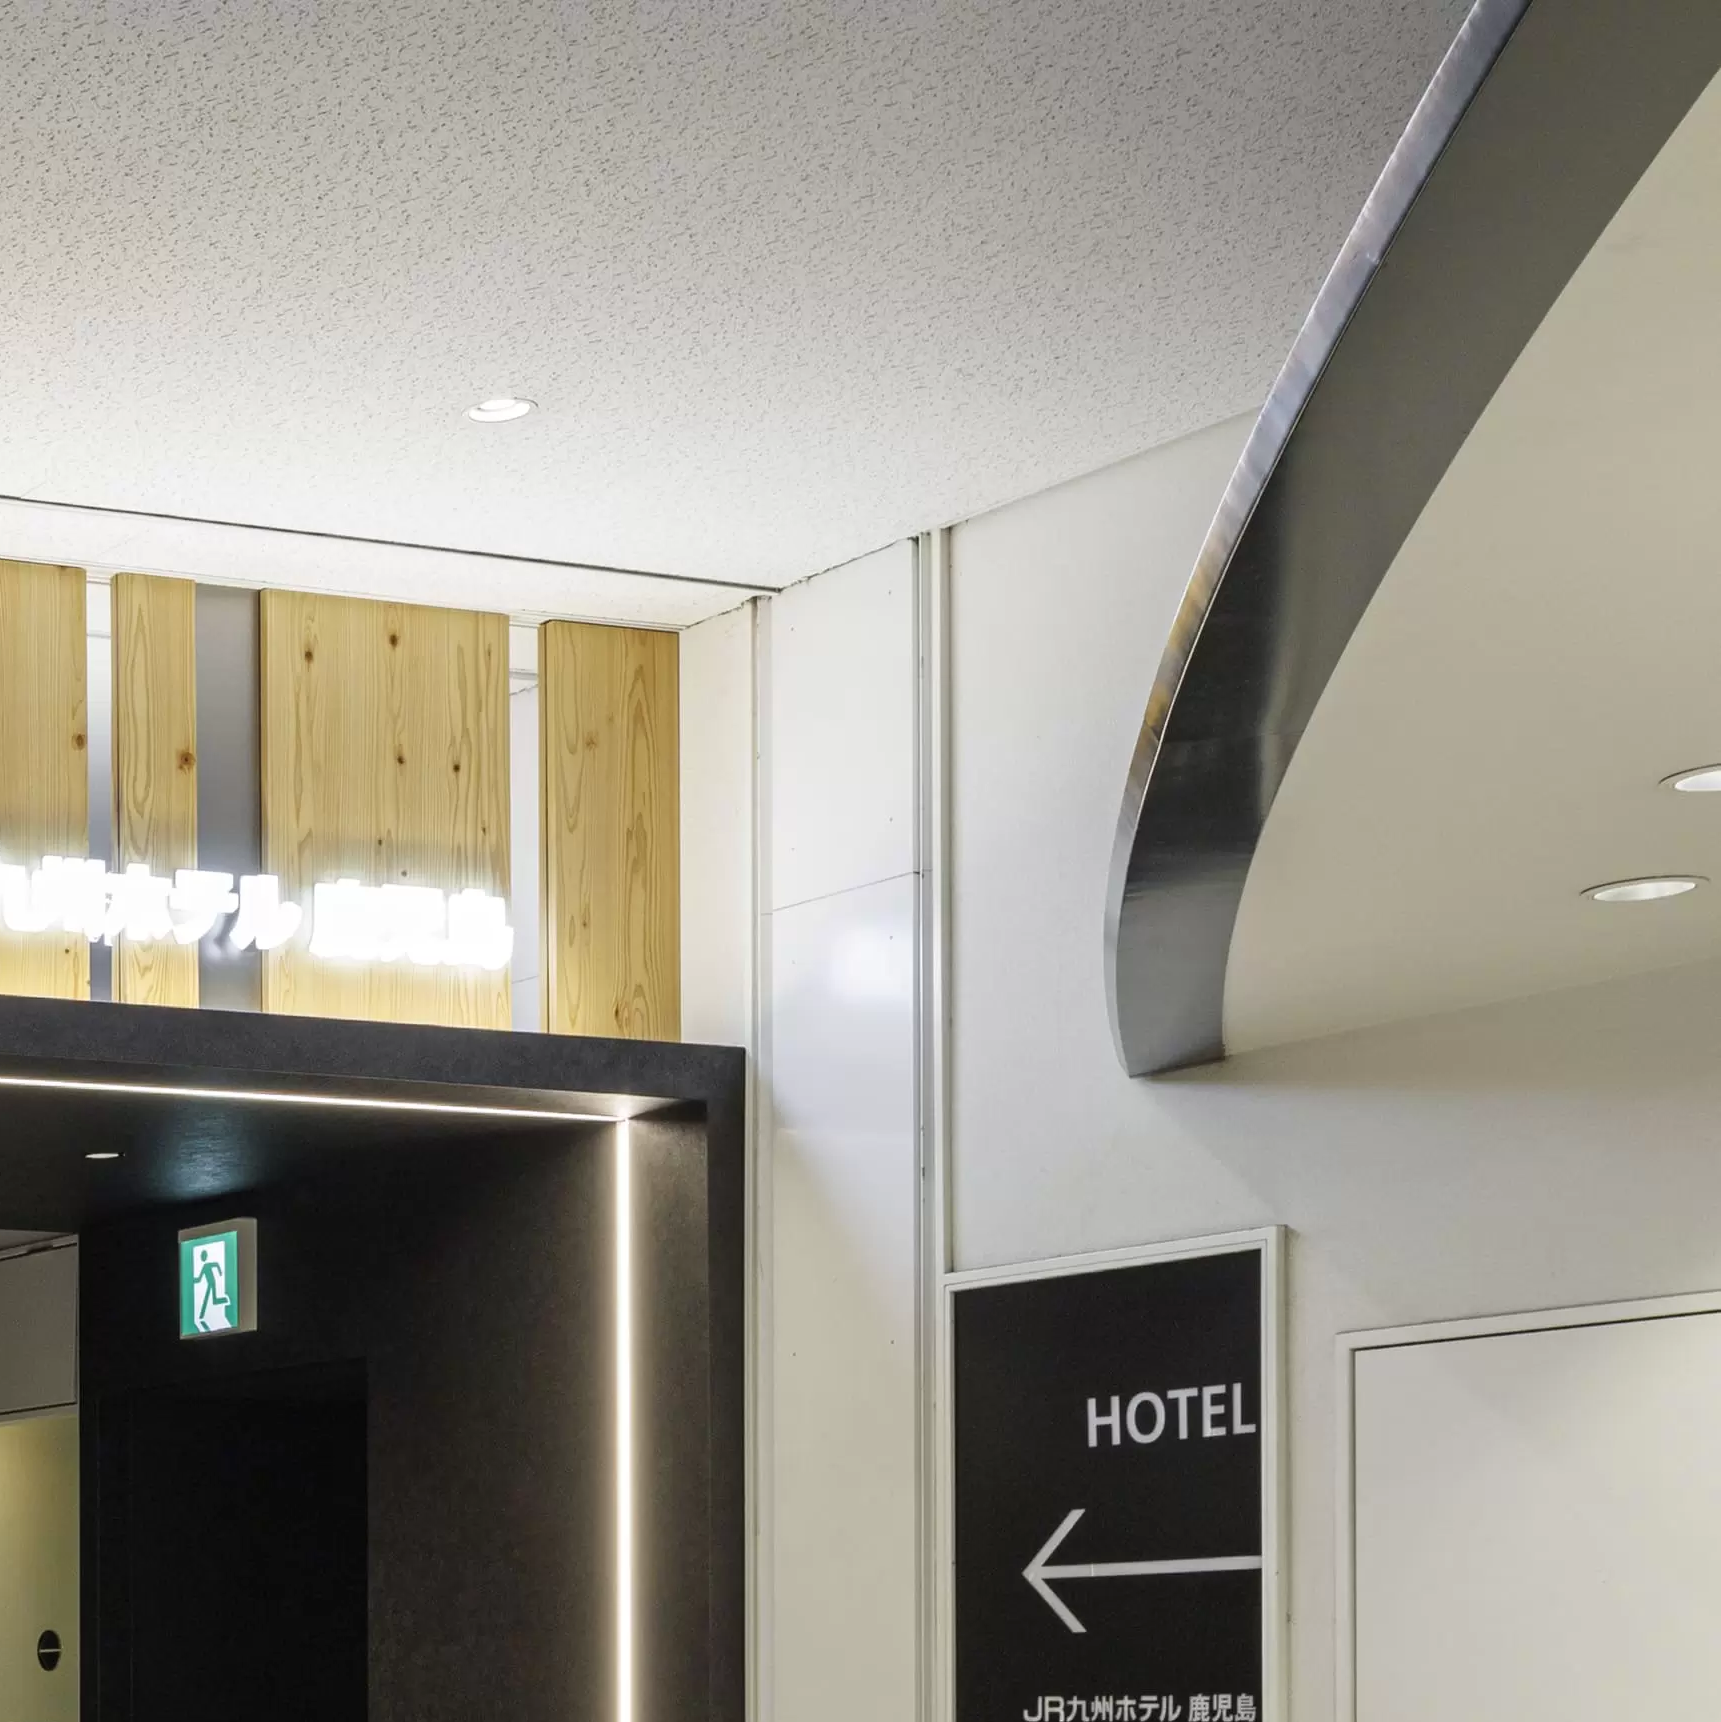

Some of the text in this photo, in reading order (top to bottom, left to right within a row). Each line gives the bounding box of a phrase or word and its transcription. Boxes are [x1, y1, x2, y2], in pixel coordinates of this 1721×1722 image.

[1086, 1382, 1257, 1448] HOTEL
[1023, 1693, 1257, 1722] JR九州ホテル 鹿児島
